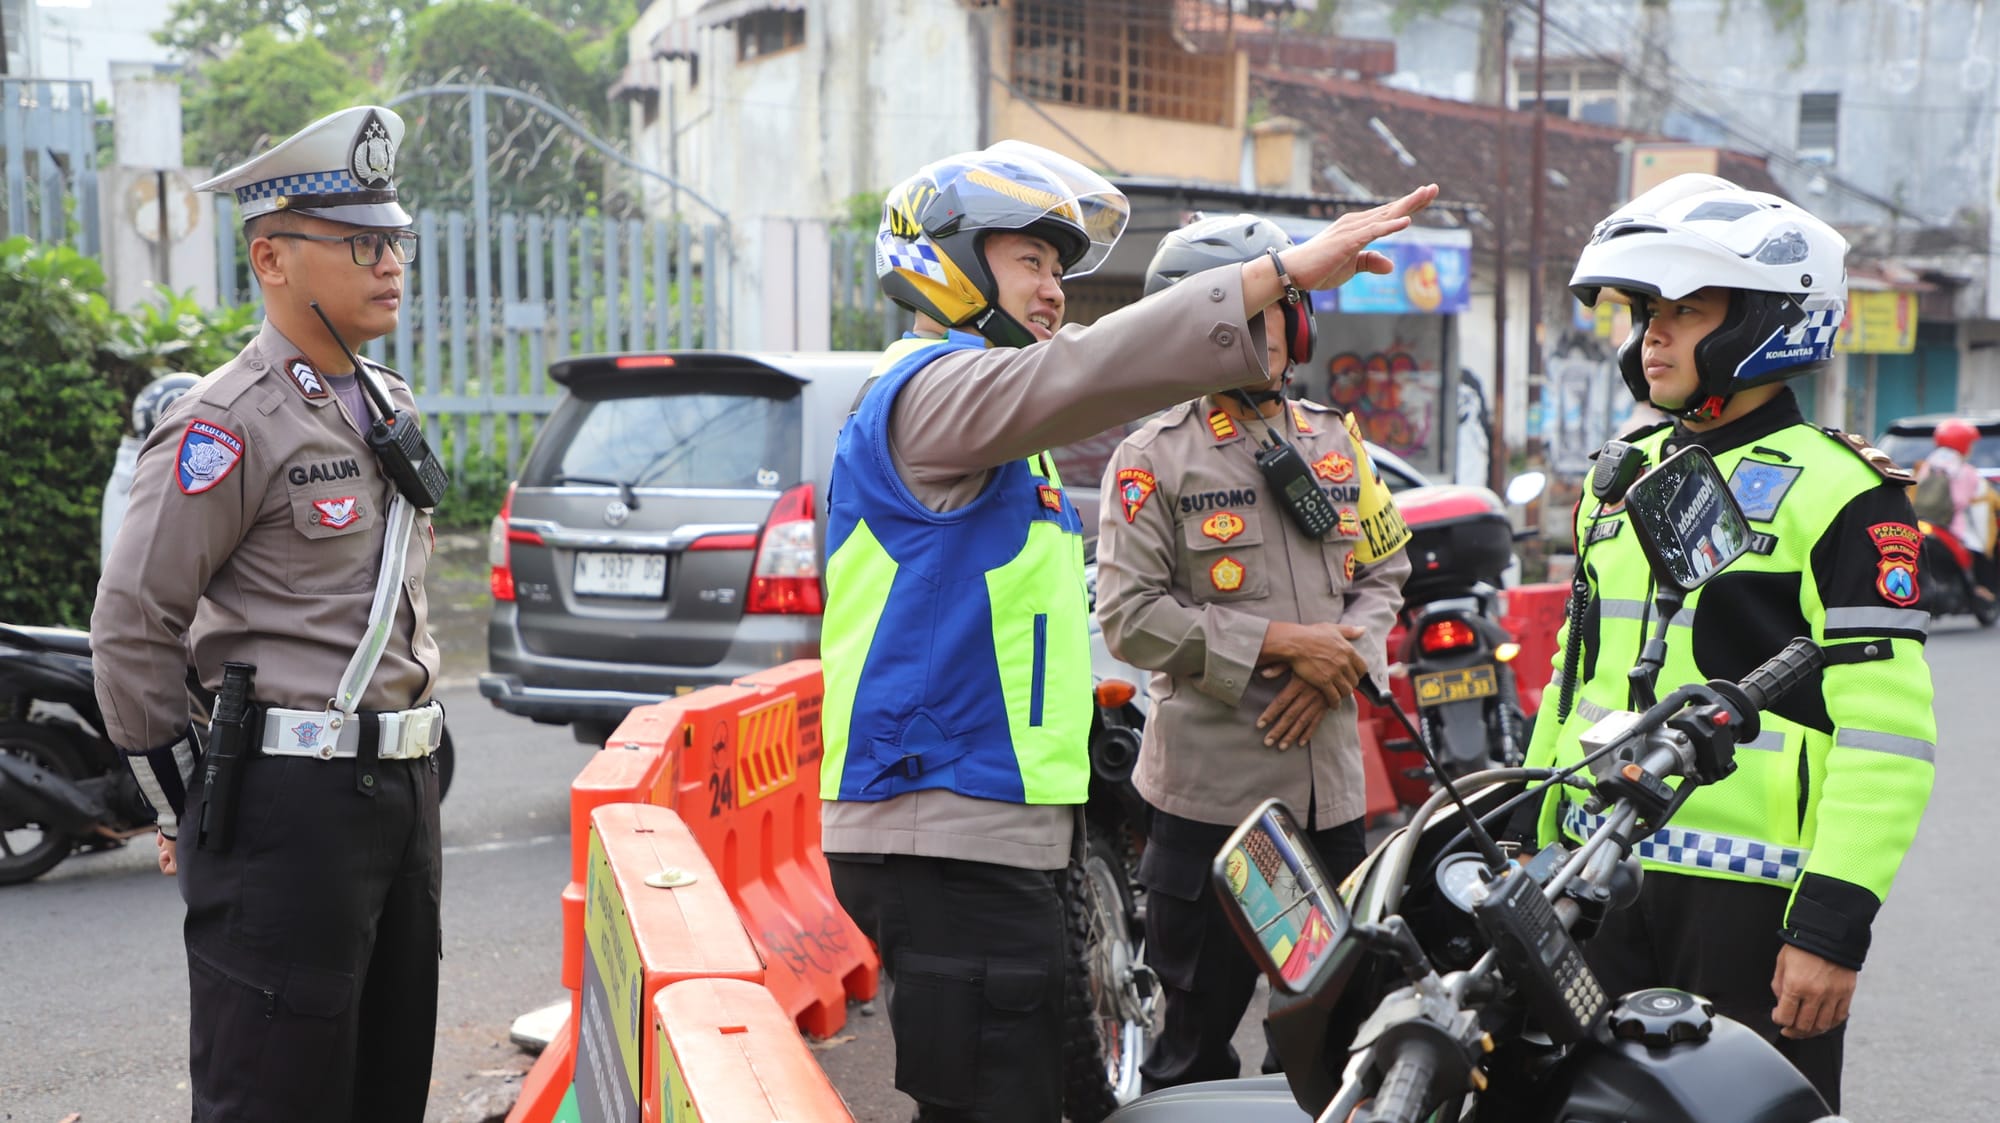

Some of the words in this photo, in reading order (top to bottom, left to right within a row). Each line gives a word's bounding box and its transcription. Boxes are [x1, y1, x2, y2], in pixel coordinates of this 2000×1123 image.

[1765, 346, 1814, 360] KORLANTAS
[288, 458, 360, 486] GALUH
[1180, 488, 1257, 513] SUTOMO
[577, 557, 587, 577] N
[600, 556, 634, 579] 1937
[709, 767, 732, 819] 24
